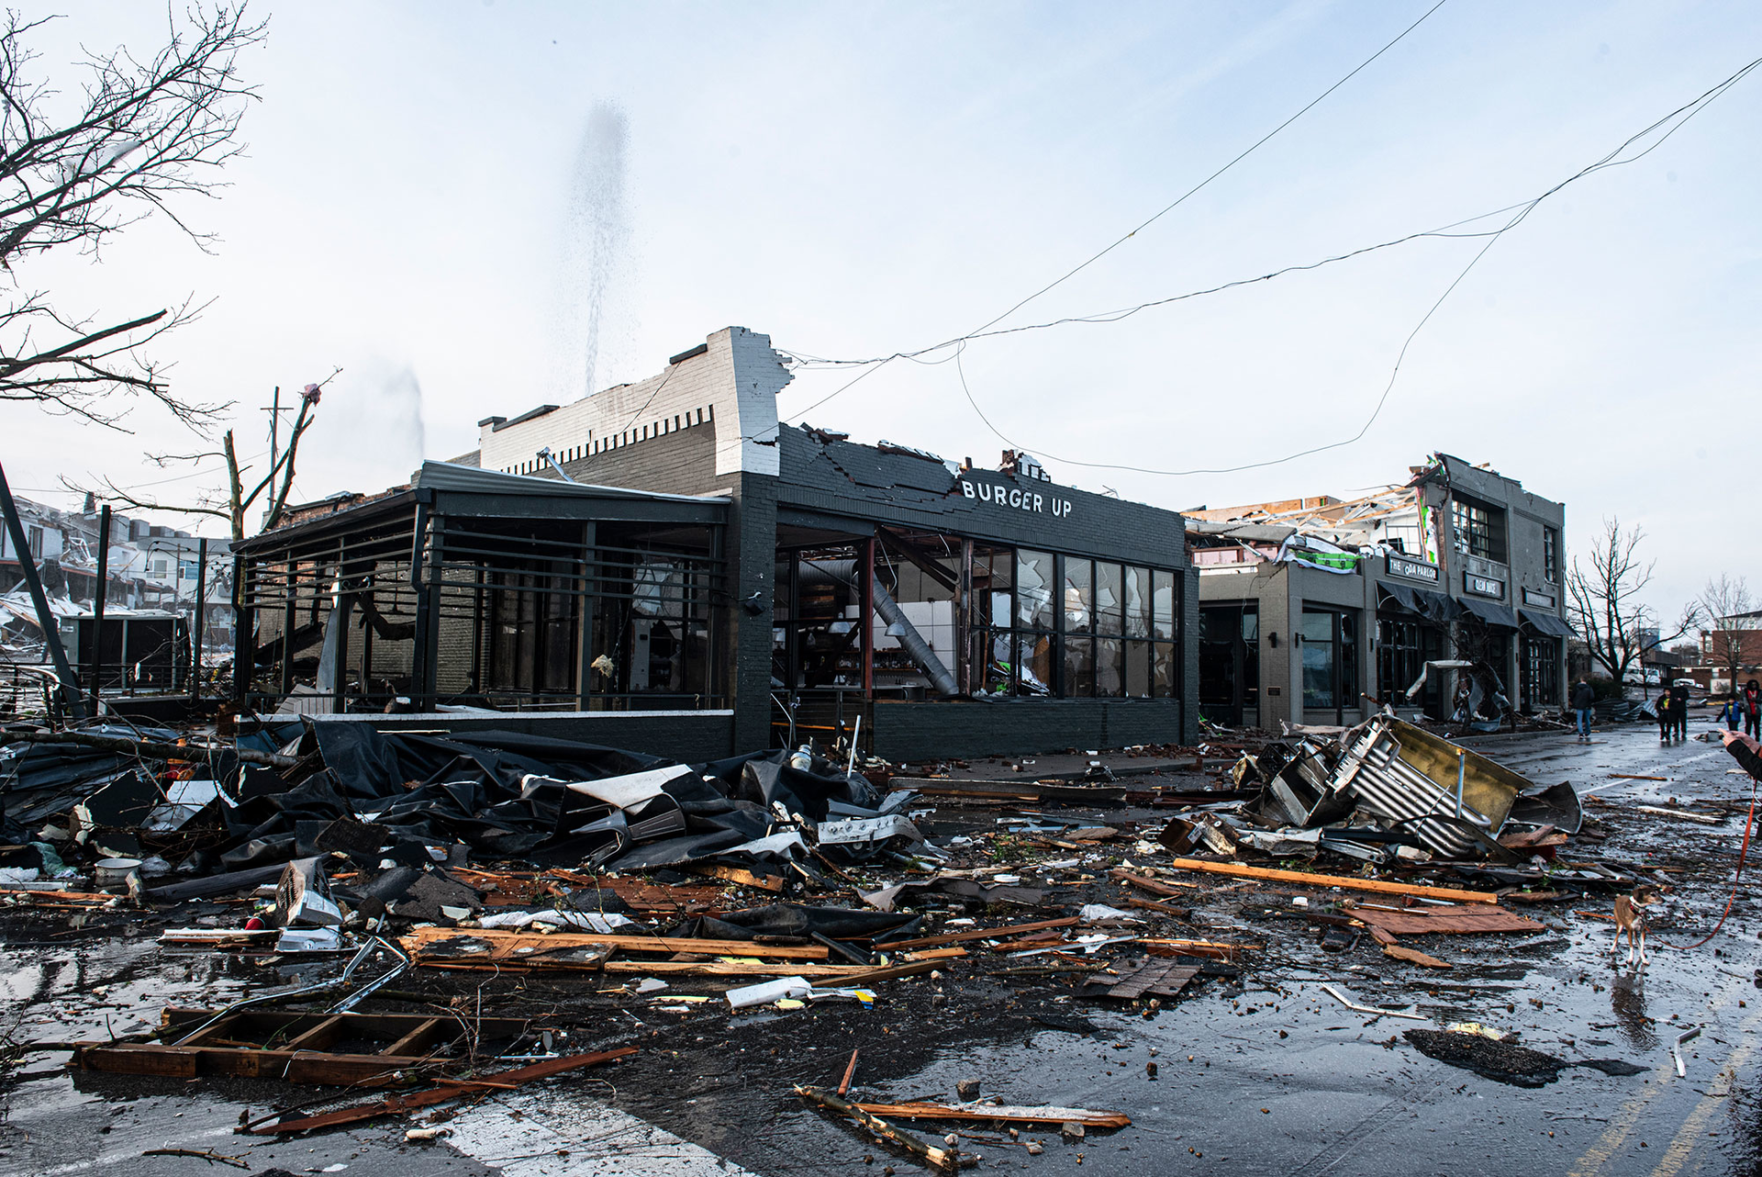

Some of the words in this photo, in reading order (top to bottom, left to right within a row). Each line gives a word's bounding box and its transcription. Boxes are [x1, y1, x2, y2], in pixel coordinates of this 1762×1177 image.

[961, 480, 1042, 512] BURGER
[1051, 498, 1072, 518] UP
[1389, 559, 1401, 571] THE
[1417, 566, 1437, 579] PARLOR
